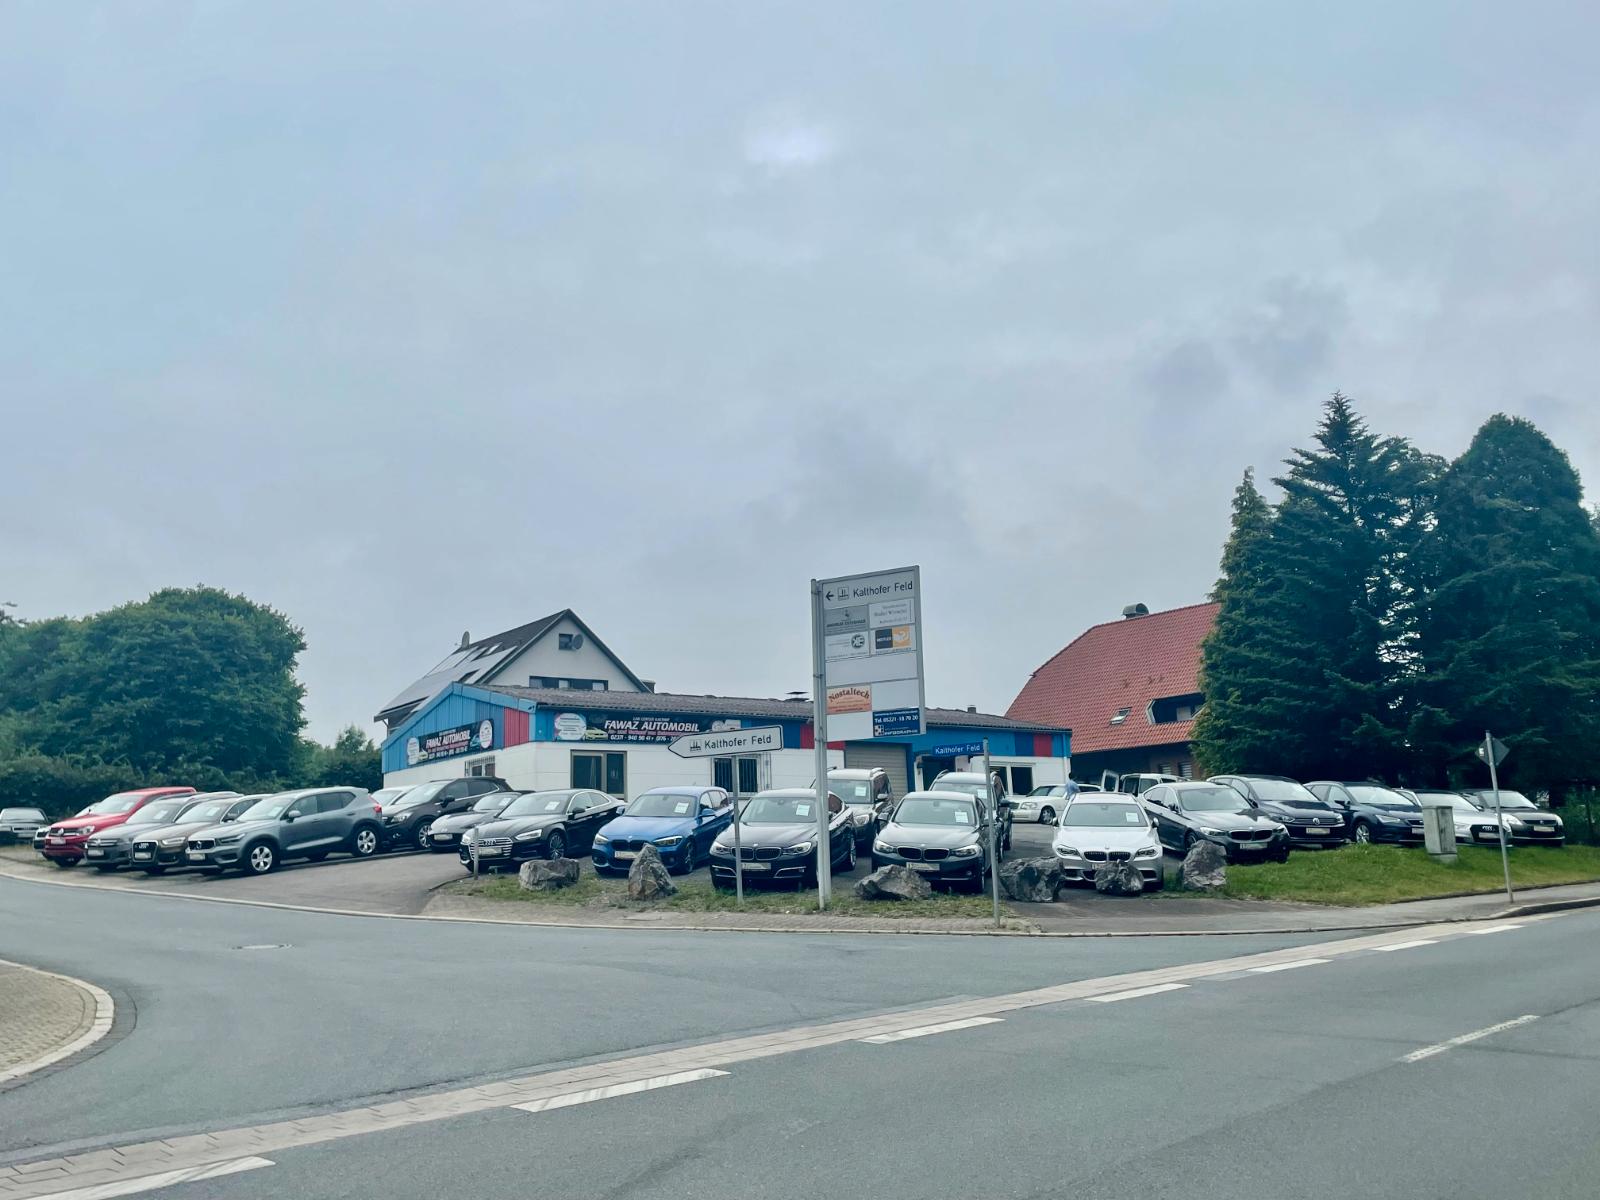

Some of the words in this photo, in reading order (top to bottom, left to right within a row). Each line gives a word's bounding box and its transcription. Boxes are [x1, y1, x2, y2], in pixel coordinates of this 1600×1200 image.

[853, 585, 890, 598] Kalthofer
[894, 581, 913, 592] Feld
[604, 720, 640, 730] FAWAZ
[641, 721, 700, 732] AUTOMOBIL
[442, 730, 471, 745] AUTOMOBIL
[704, 737, 747, 749] Kalthofer
[751, 735, 772, 745] Feld
[935, 745, 964, 754] Kalthofer
